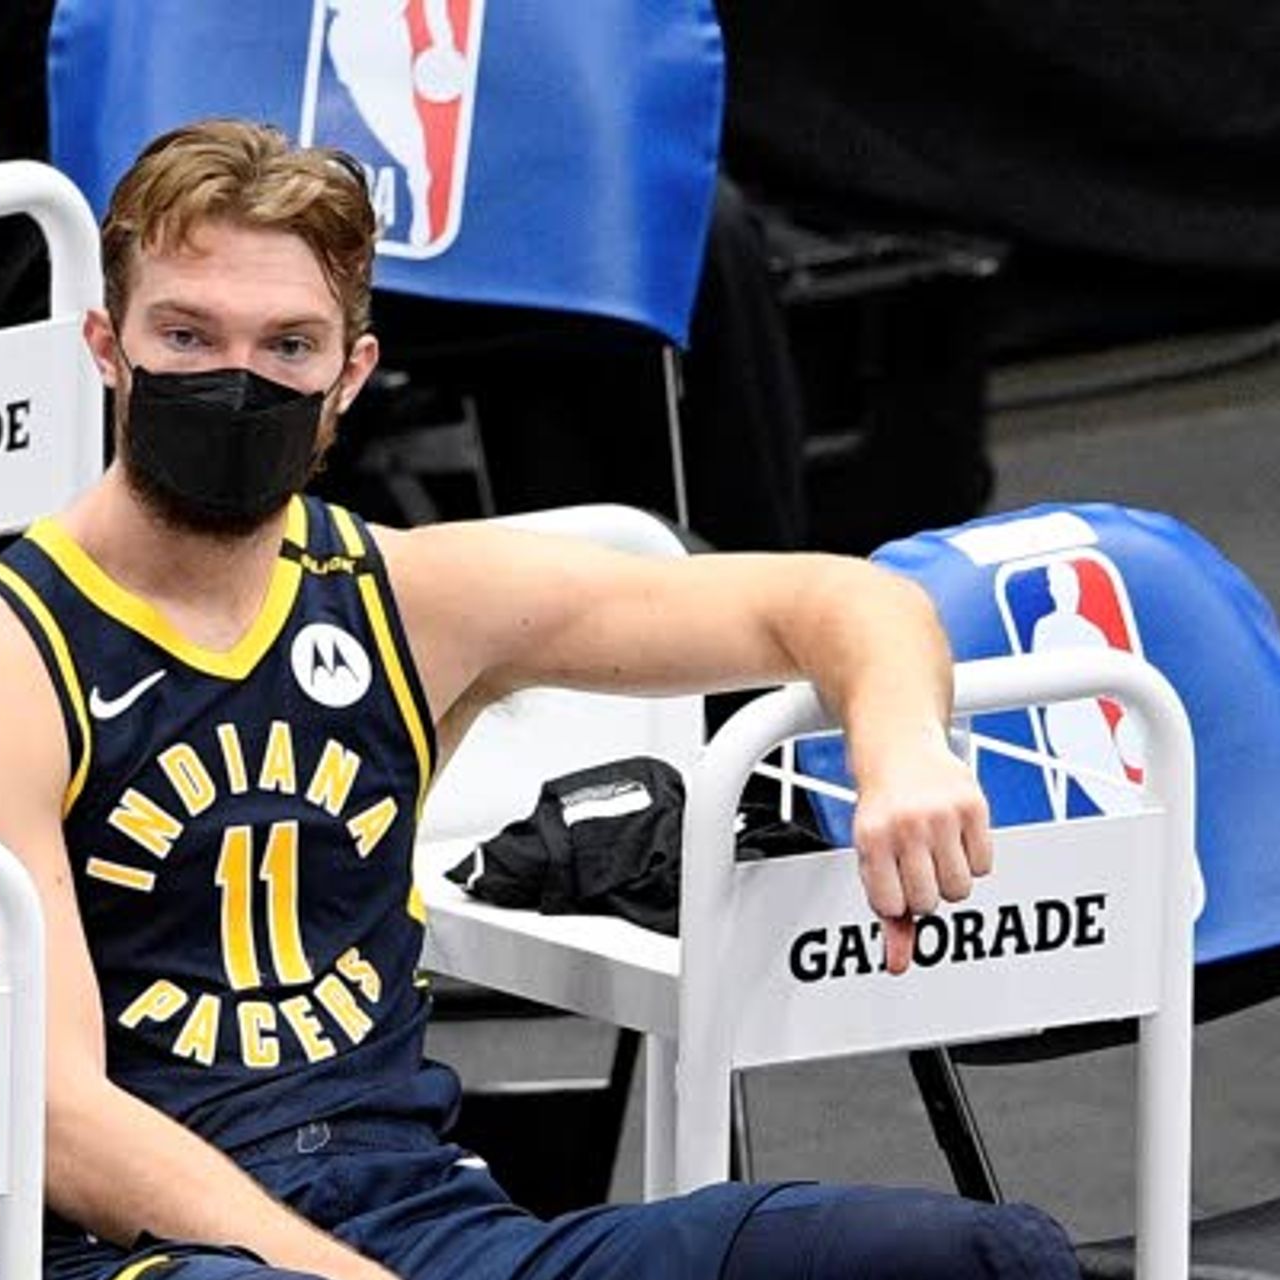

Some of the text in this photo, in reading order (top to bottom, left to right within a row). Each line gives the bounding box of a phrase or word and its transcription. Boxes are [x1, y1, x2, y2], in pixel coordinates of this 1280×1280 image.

[86, 720, 398, 892] INDIANA
[214, 820, 315, 991] 11
[118, 947, 382, 1069] PACERS
